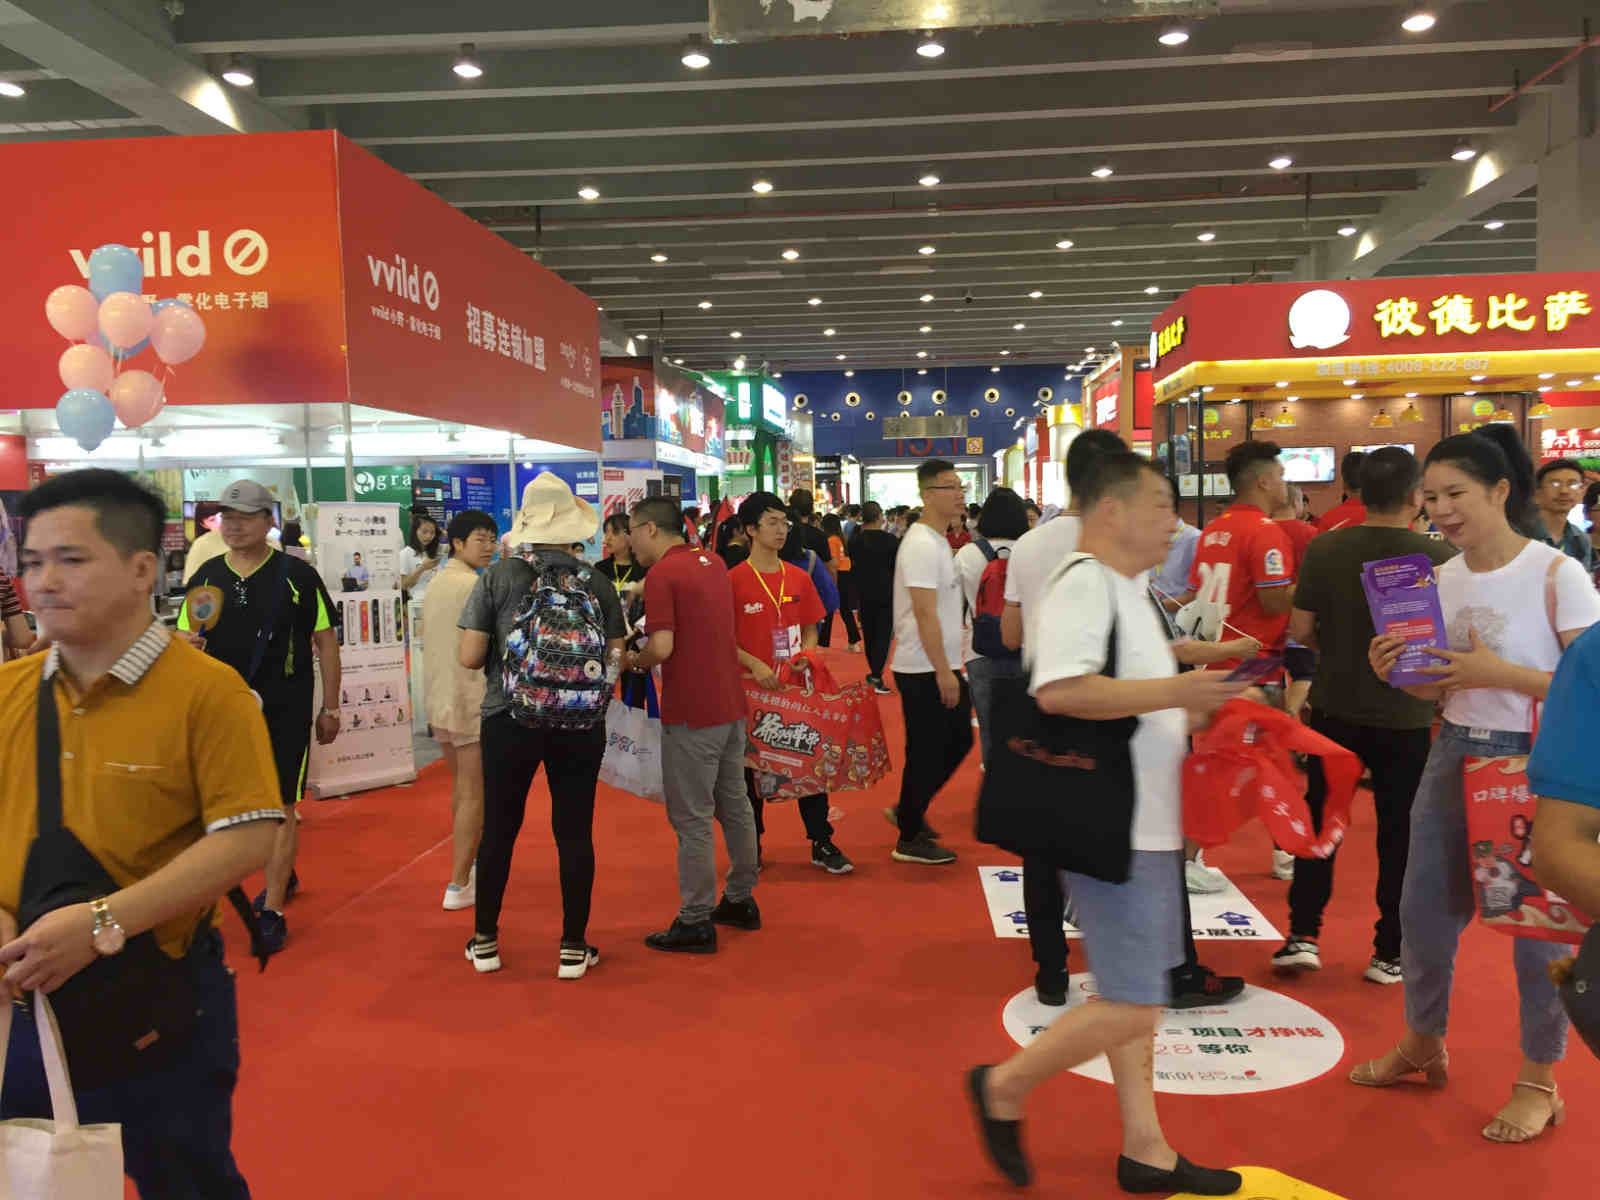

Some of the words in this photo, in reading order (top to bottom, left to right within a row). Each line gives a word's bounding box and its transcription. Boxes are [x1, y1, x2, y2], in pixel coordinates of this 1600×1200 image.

[466, 301, 547, 372] 招募连锁加盟
[1373, 290, 1593, 338] 彼德比萨
